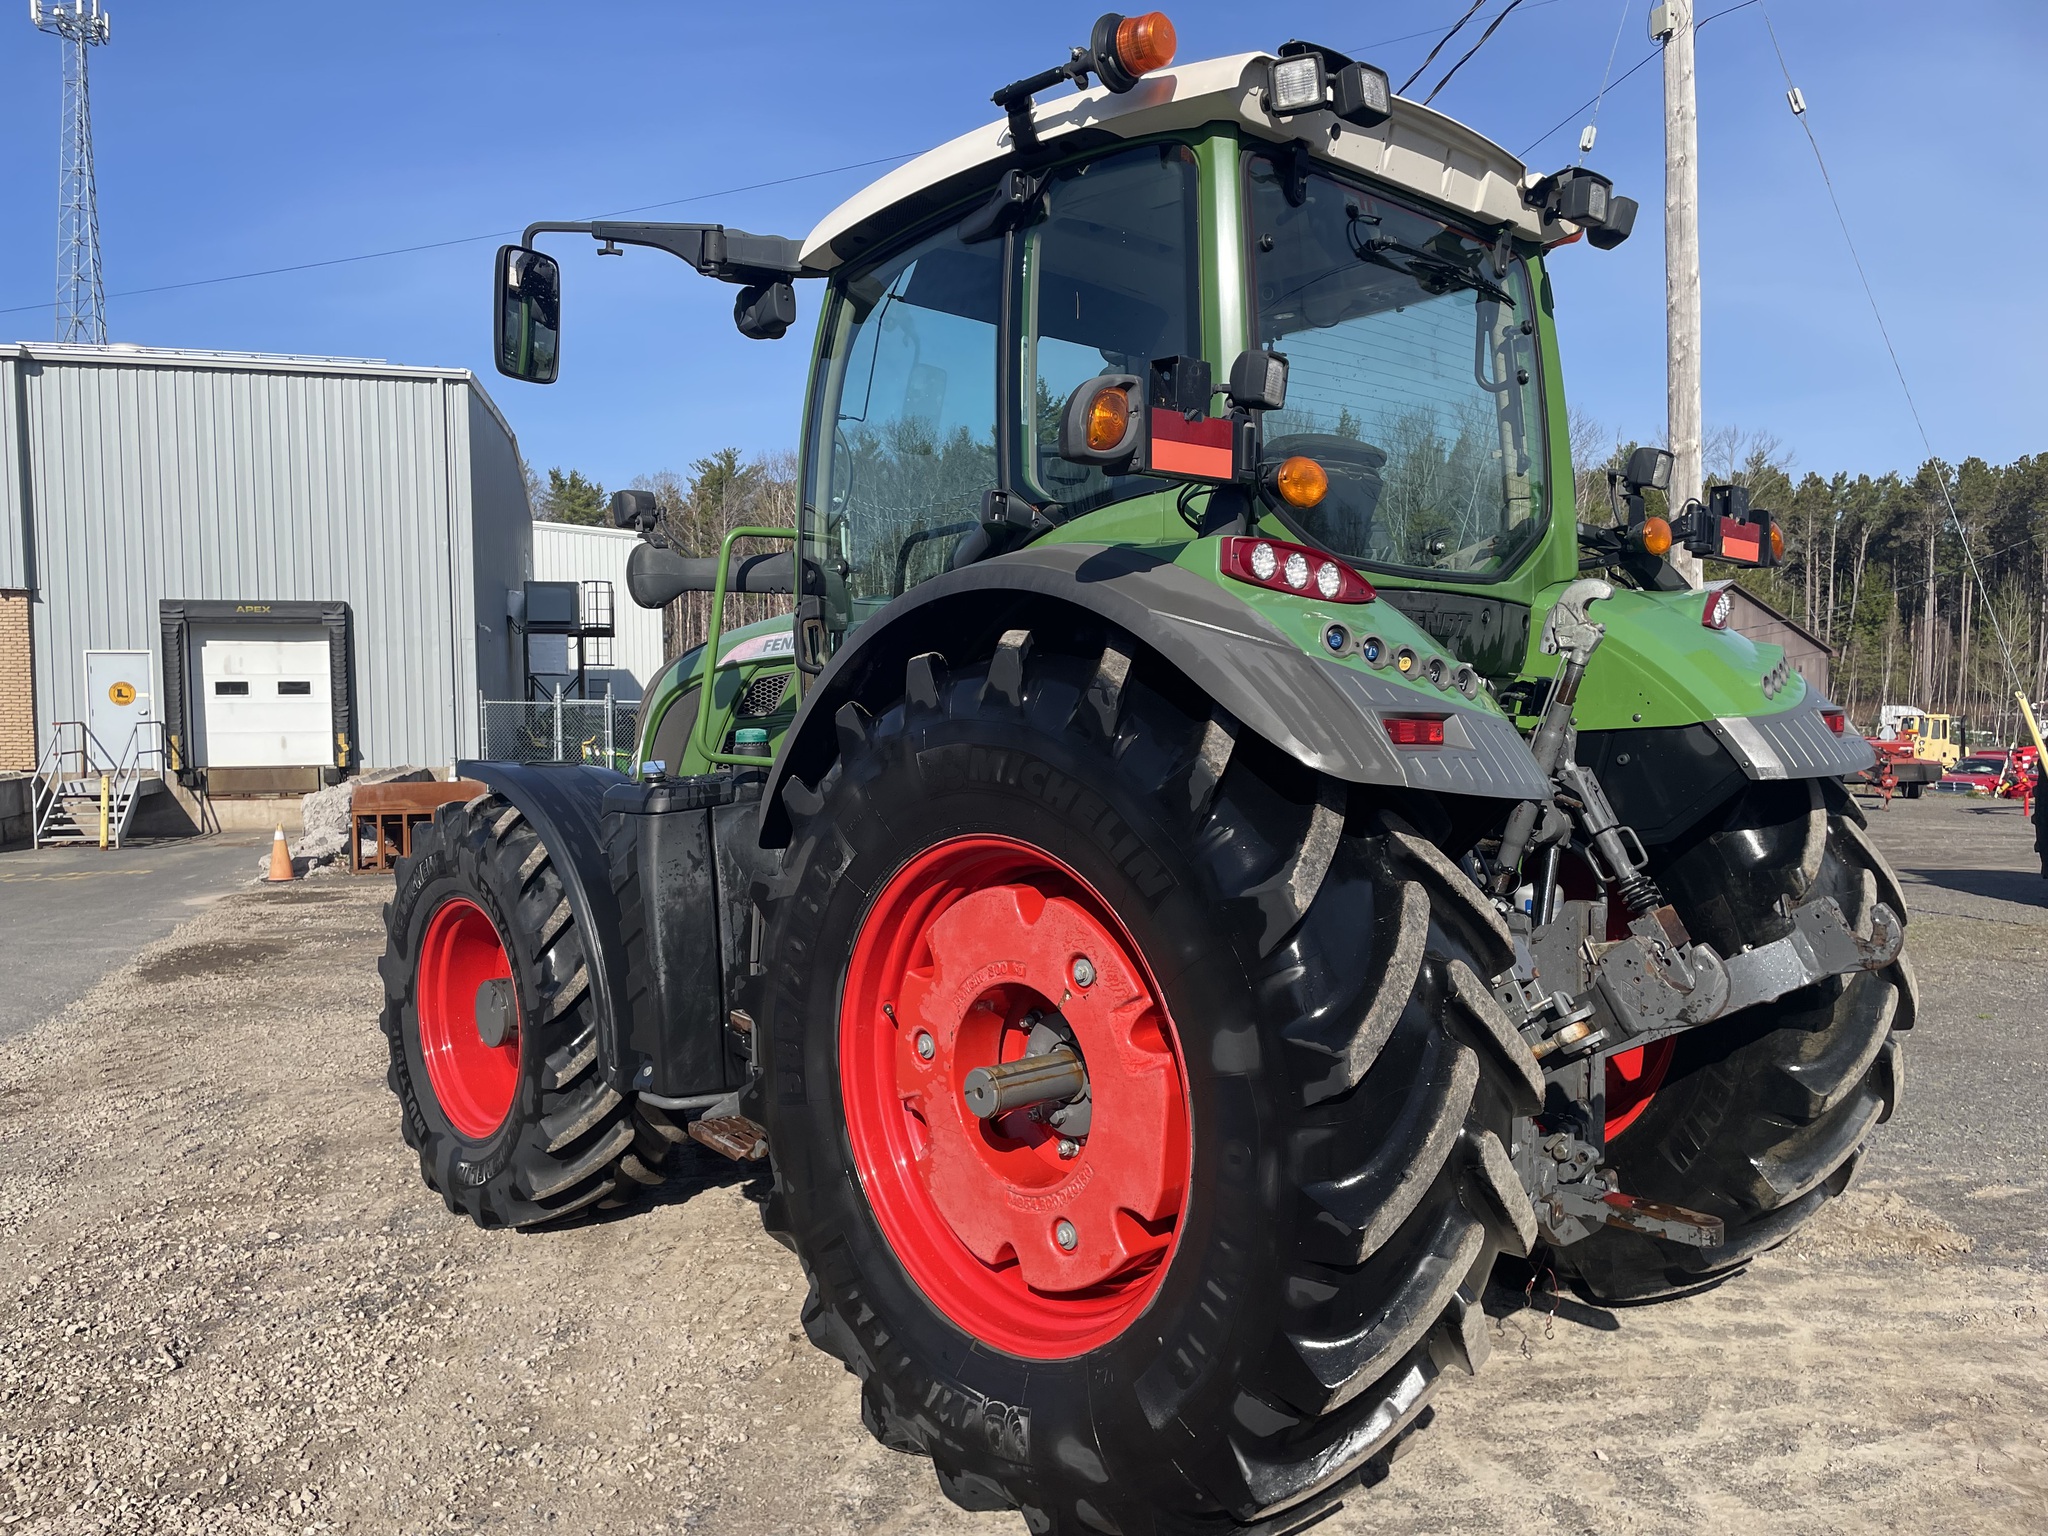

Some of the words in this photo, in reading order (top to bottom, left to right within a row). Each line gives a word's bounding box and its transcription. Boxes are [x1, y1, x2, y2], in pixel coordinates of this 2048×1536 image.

[236, 605, 271, 613] APEX
[762, 637, 794, 653] FEN
[969, 748, 1172, 898] MICHELIN
